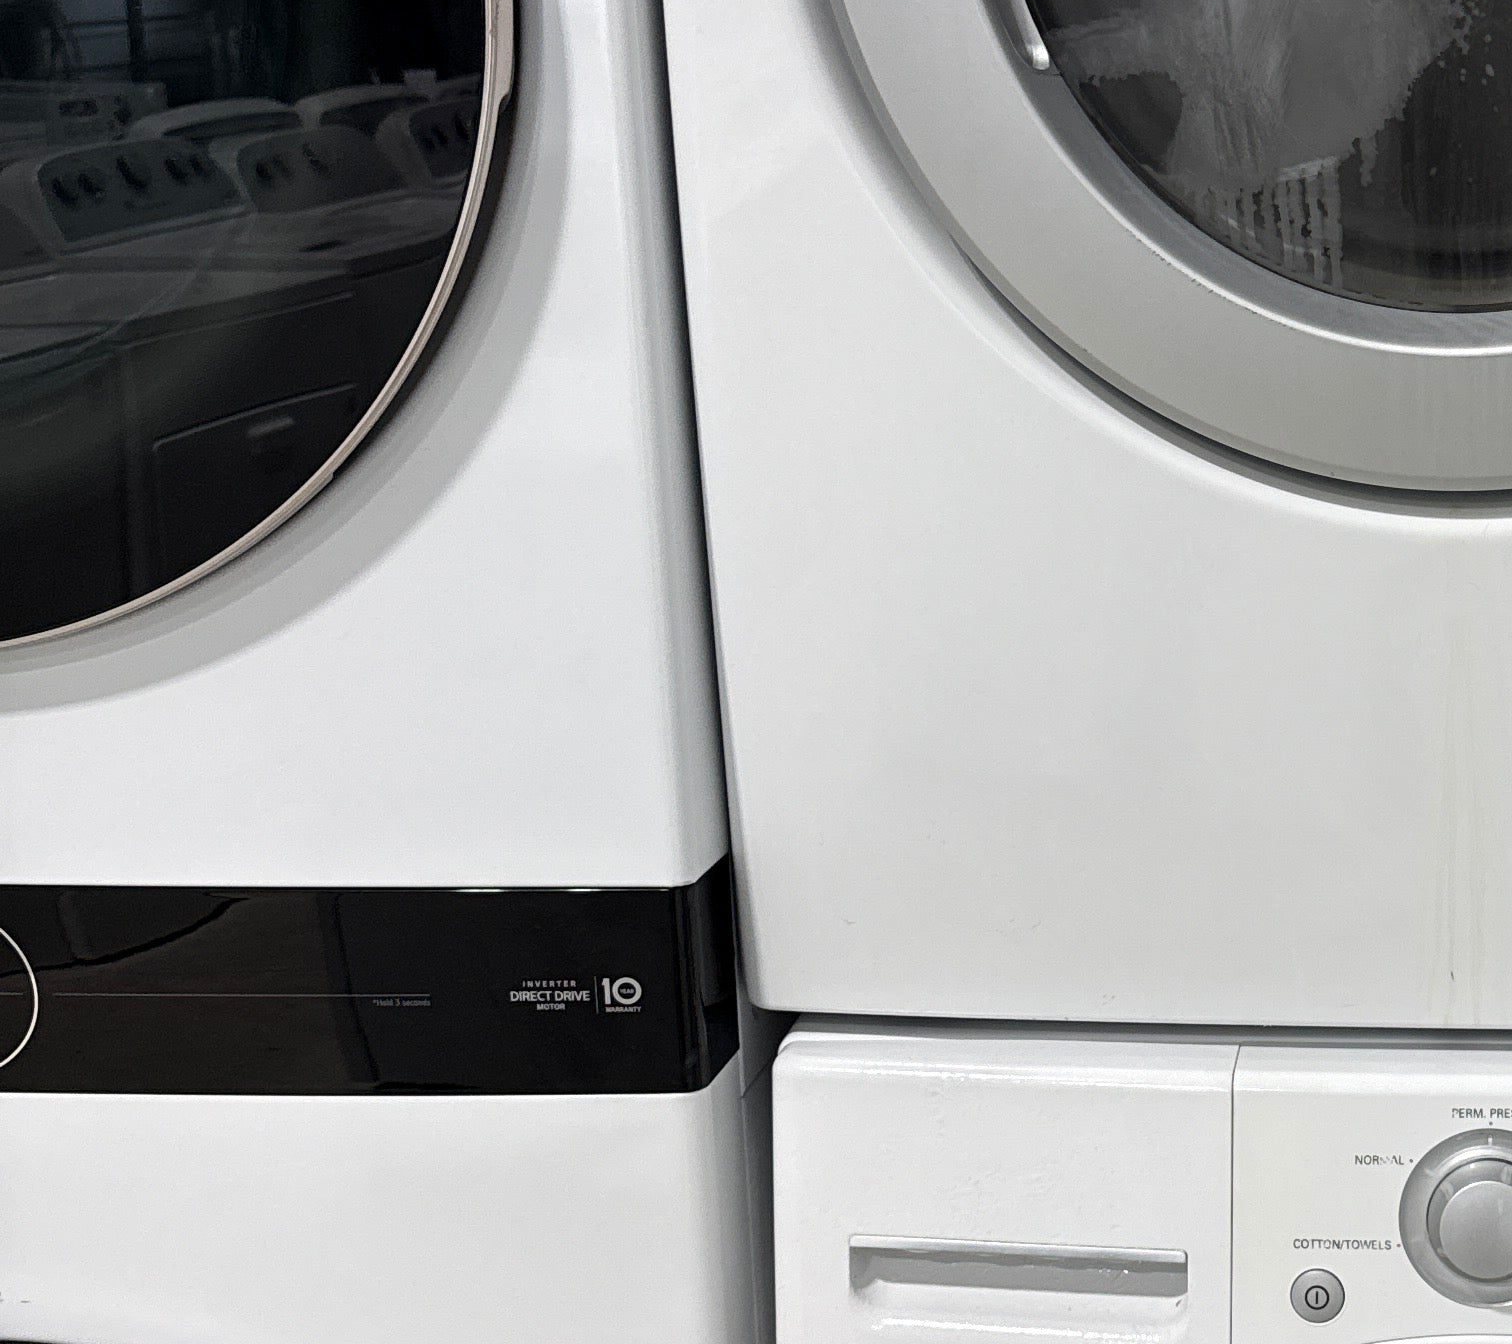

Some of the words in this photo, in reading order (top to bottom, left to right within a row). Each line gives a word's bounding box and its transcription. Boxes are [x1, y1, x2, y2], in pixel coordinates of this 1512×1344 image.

[522, 980, 577, 988] INVERTER
[509, 990, 552, 1002] DIRECT
[554, 990, 591, 1002] DRIVE
[602, 976, 642, 1005] 10
[536, 1003, 566, 1011] MOTOR
[1292, 1238, 1393, 1250] COTTON/TOWELS
